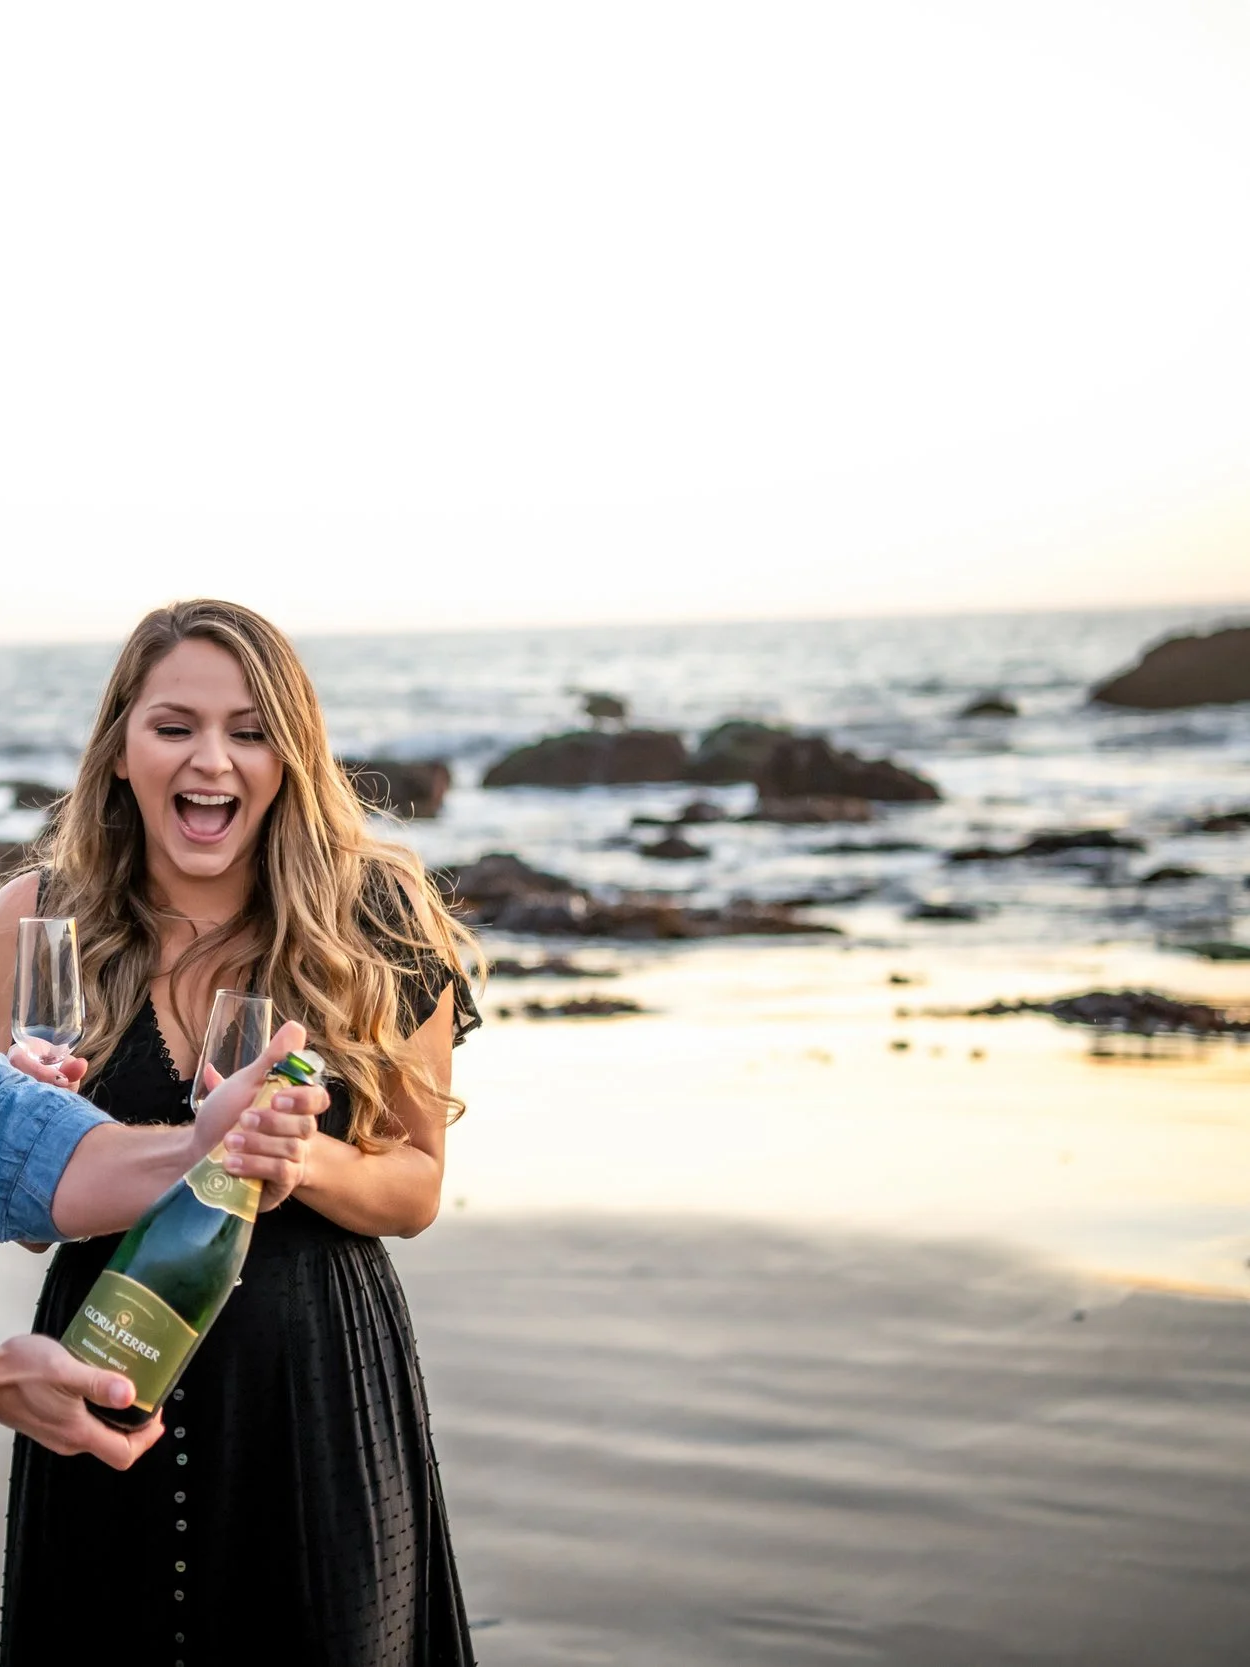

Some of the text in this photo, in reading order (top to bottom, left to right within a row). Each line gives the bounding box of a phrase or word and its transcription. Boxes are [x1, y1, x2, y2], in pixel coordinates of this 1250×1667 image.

[81, 1338, 107, 1360] SONOMA
[108, 1356, 128, 1372] BRUT
[84, 1305, 116, 1336] GLORIA
[116, 1329, 160, 1363] FERRER
